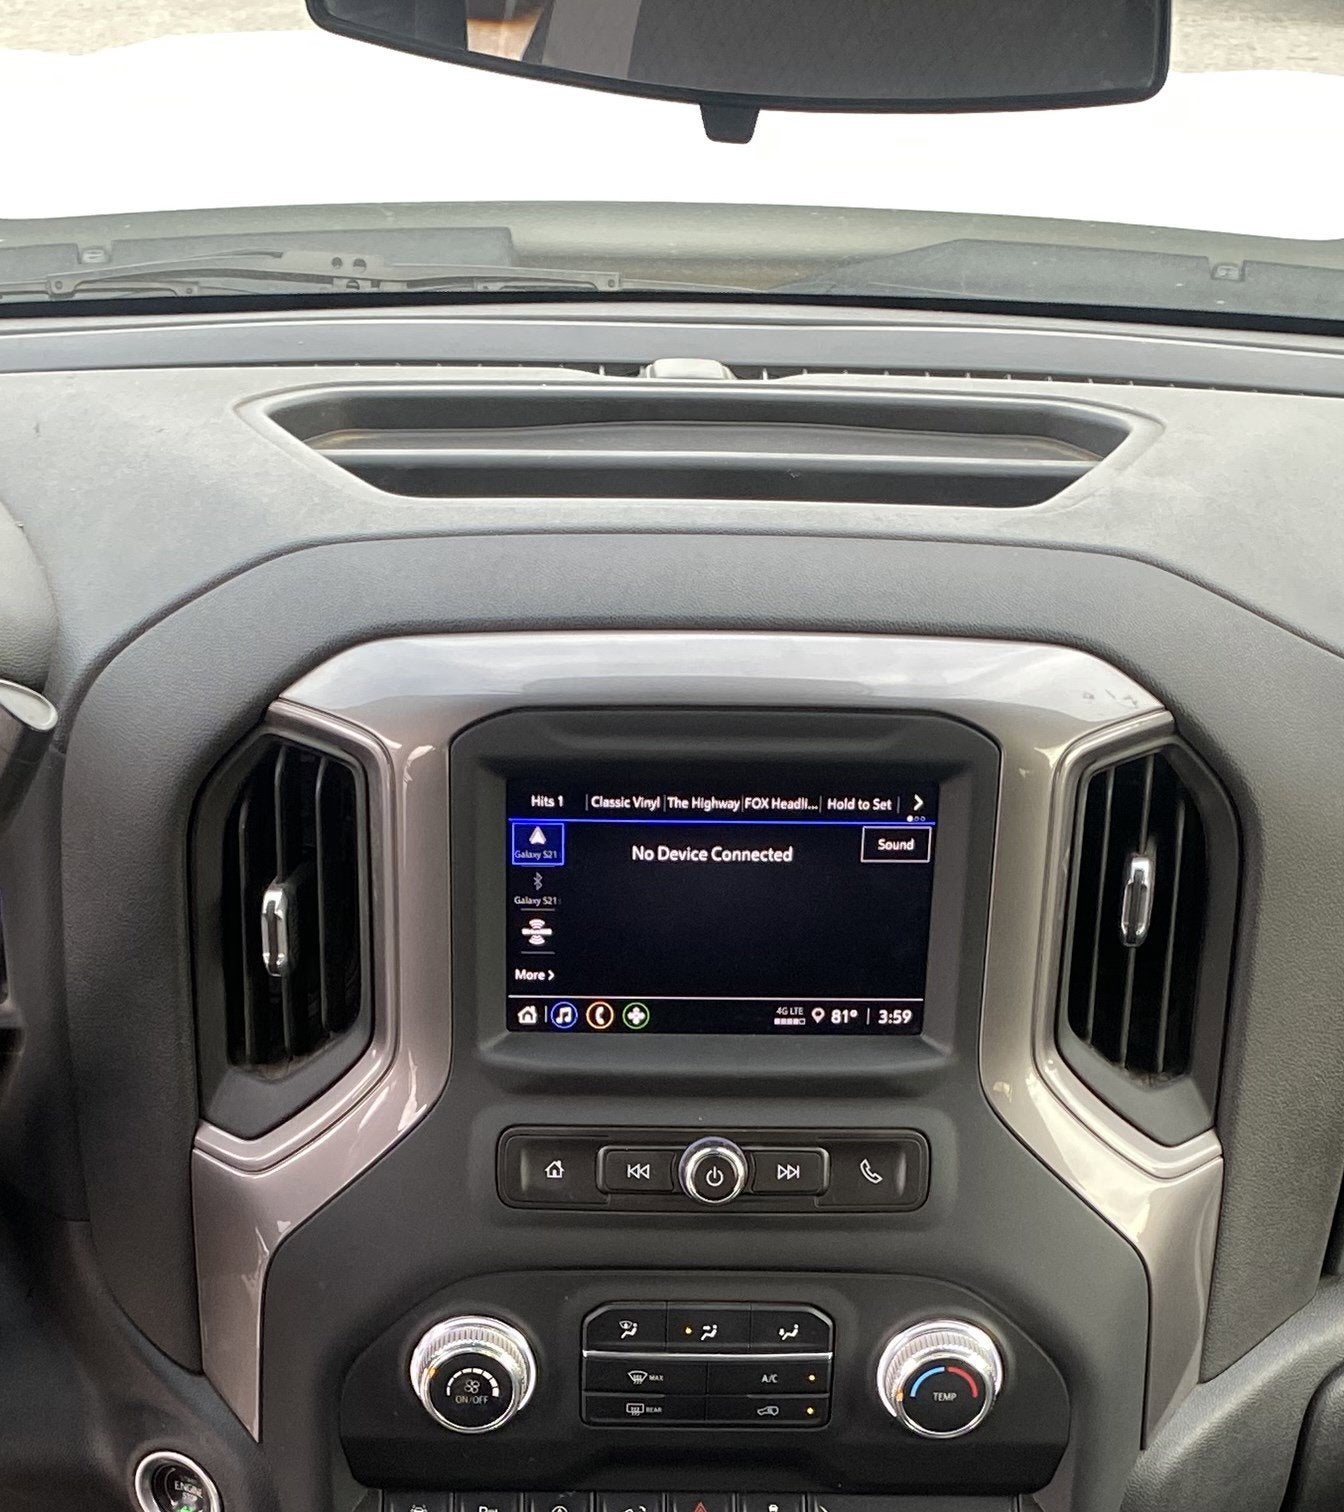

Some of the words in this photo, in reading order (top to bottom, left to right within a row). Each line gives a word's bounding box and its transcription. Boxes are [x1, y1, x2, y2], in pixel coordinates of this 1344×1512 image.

[531, 795, 555, 808] Hits
[591, 796, 631, 810] Classic
[632, 796, 661, 812] Vinyl
[667, 797, 689, 810] The
[691, 797, 740, 813] Highway
[744, 798, 768, 811] FOX
[827, 799, 855, 812] Hold
[858, 800, 869, 812] to
[871, 799, 892, 812] Set
[877, 838, 914, 852] Sound
[514, 850, 541, 860] Galaxy
[631, 846, 654, 861] No
[658, 846, 708, 861] Device
[711, 847, 794, 862] Connected
[514, 896, 541, 906] Galaxy
[515, 969, 545, 981] More
[776, 1006, 788, 1016] 4G
[789, 1006, 804, 1016] LTE
[878, 1010, 912, 1024] 3:59
[761, 1374, 778, 1384] A/C
[933, 1392, 957, 1401] TEMP
